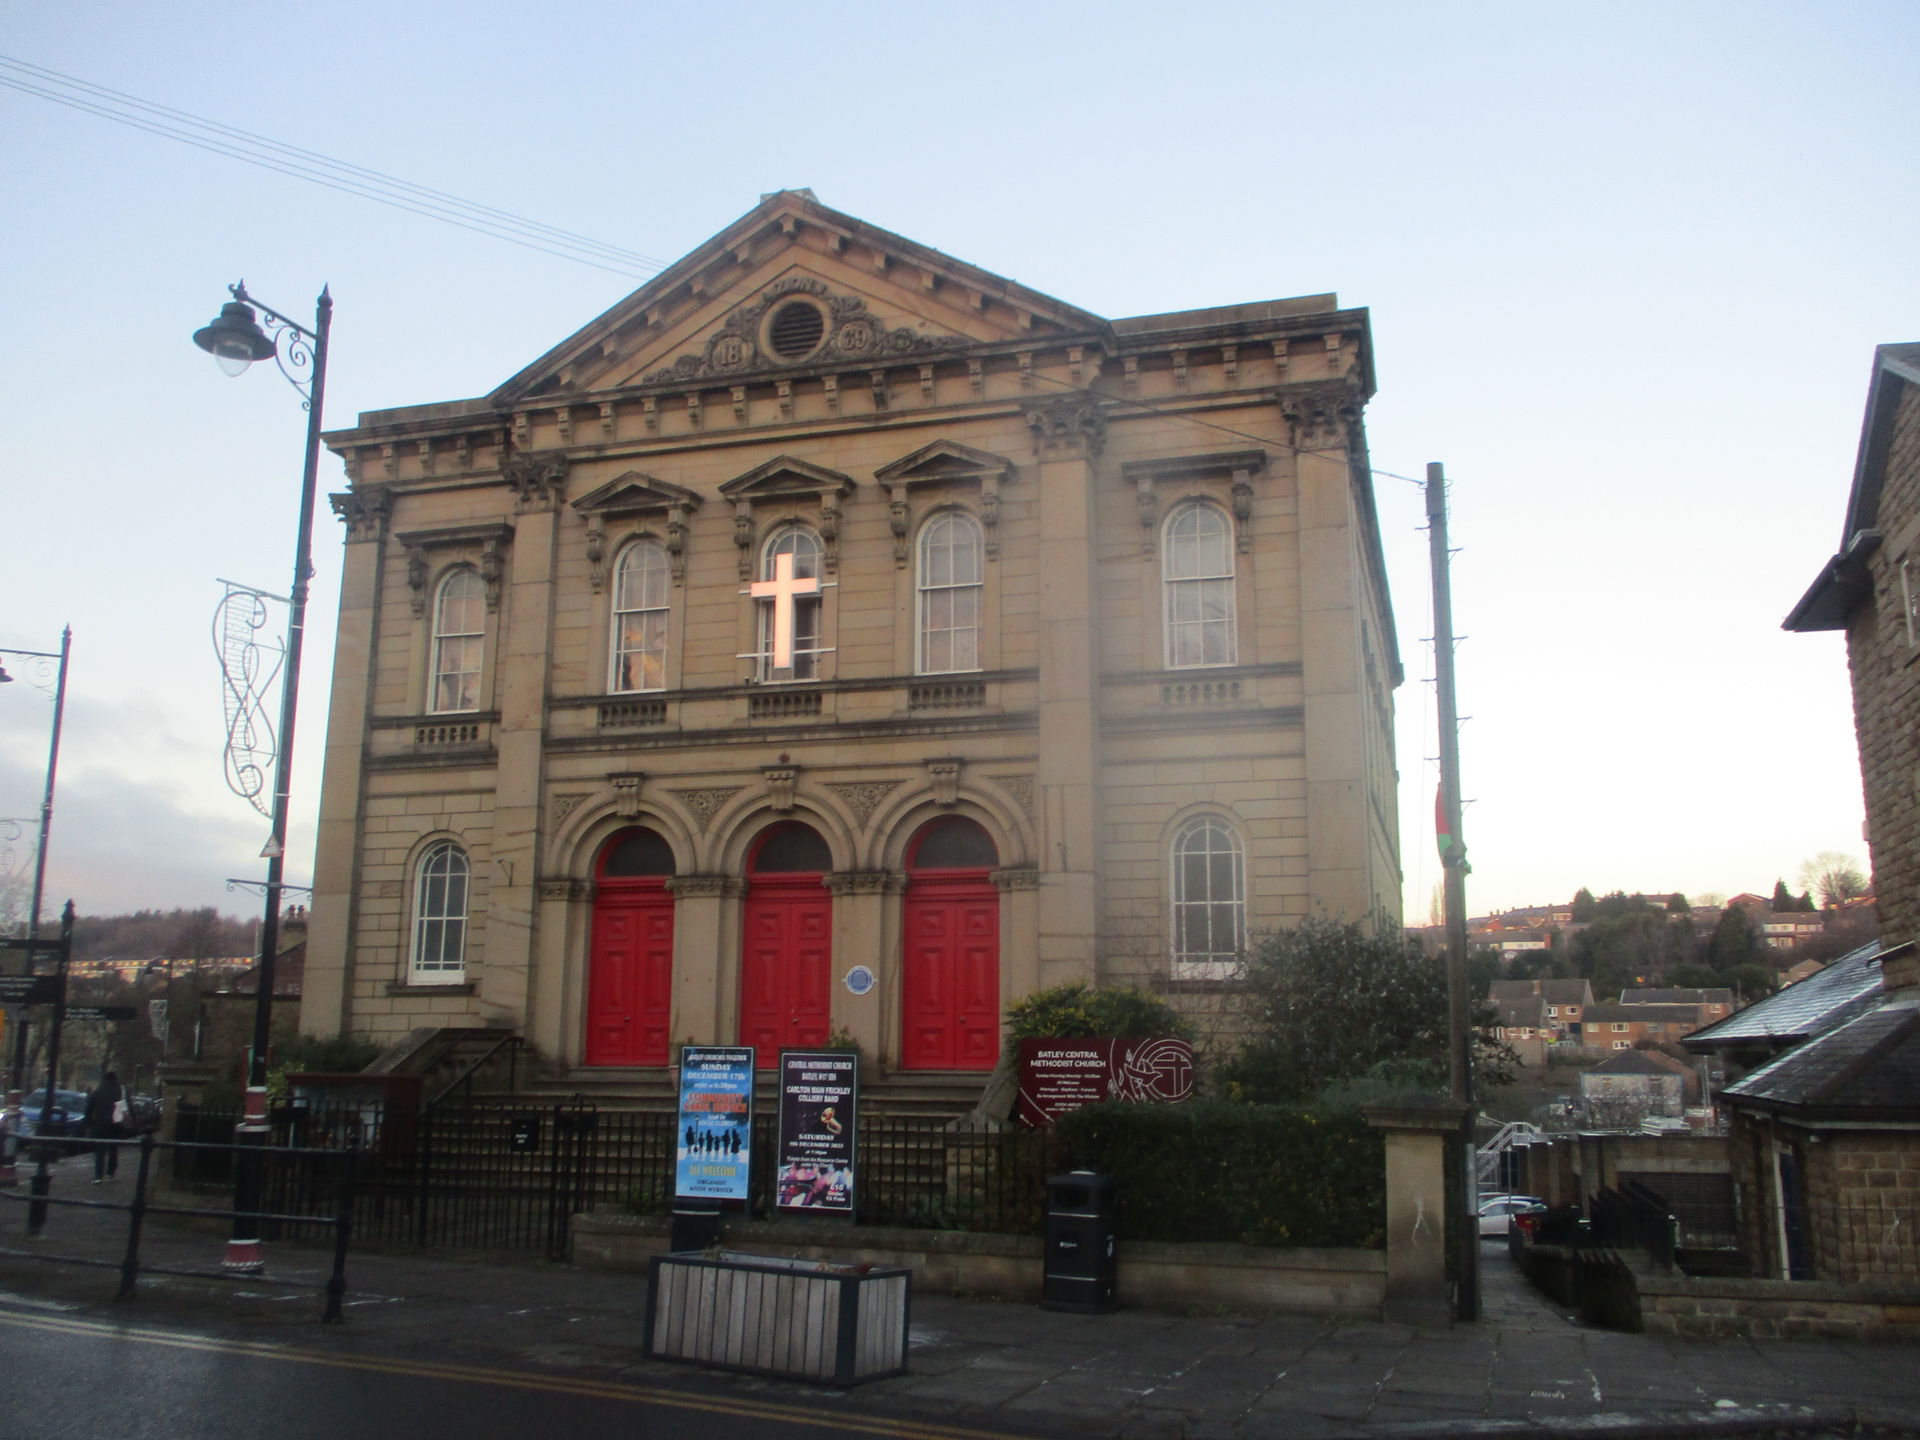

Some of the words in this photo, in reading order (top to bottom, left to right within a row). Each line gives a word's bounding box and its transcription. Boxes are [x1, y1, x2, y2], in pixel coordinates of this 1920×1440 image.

[843, 328, 869, 349] 69
[720, 344, 739, 365] 18
[1065, 1051, 1098, 1059] CENTRAL
[788, 1061, 807, 1069] CENTRAL
[807, 1061, 833, 1069] METHODIST
[833, 1062, 853, 1070] CHURCH
[1074, 1060, 1106, 1068] CHURCH
[687, 1072, 728, 1080] DECEMBER
[825, 1087, 851, 1095] FRICKLEY
[703, 1166, 737, 1177] WELCOME
